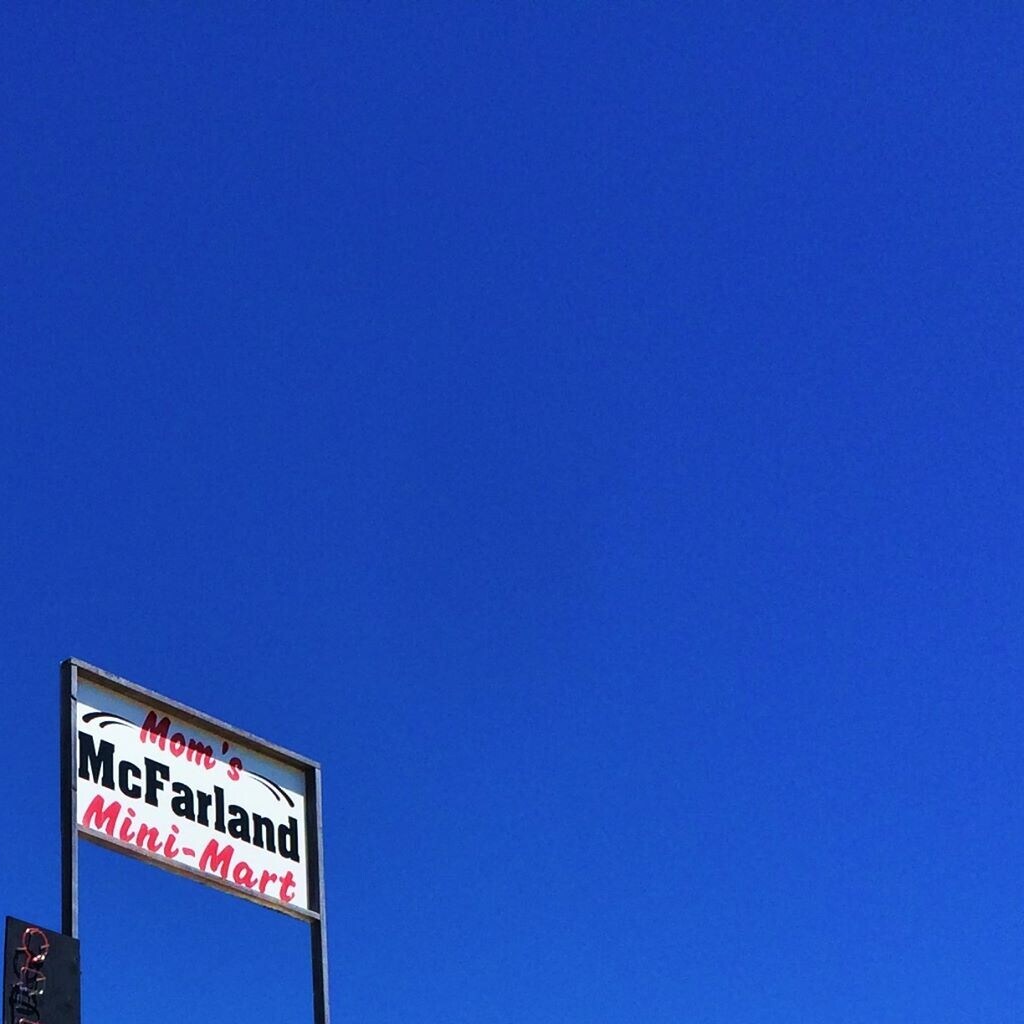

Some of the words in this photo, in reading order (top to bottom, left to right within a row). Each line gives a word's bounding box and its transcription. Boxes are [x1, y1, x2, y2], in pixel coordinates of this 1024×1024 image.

[77, 730, 301, 863] McFarland
[139, 709, 243, 781] Mom's
[82, 794, 296, 904] Mini-Mart
